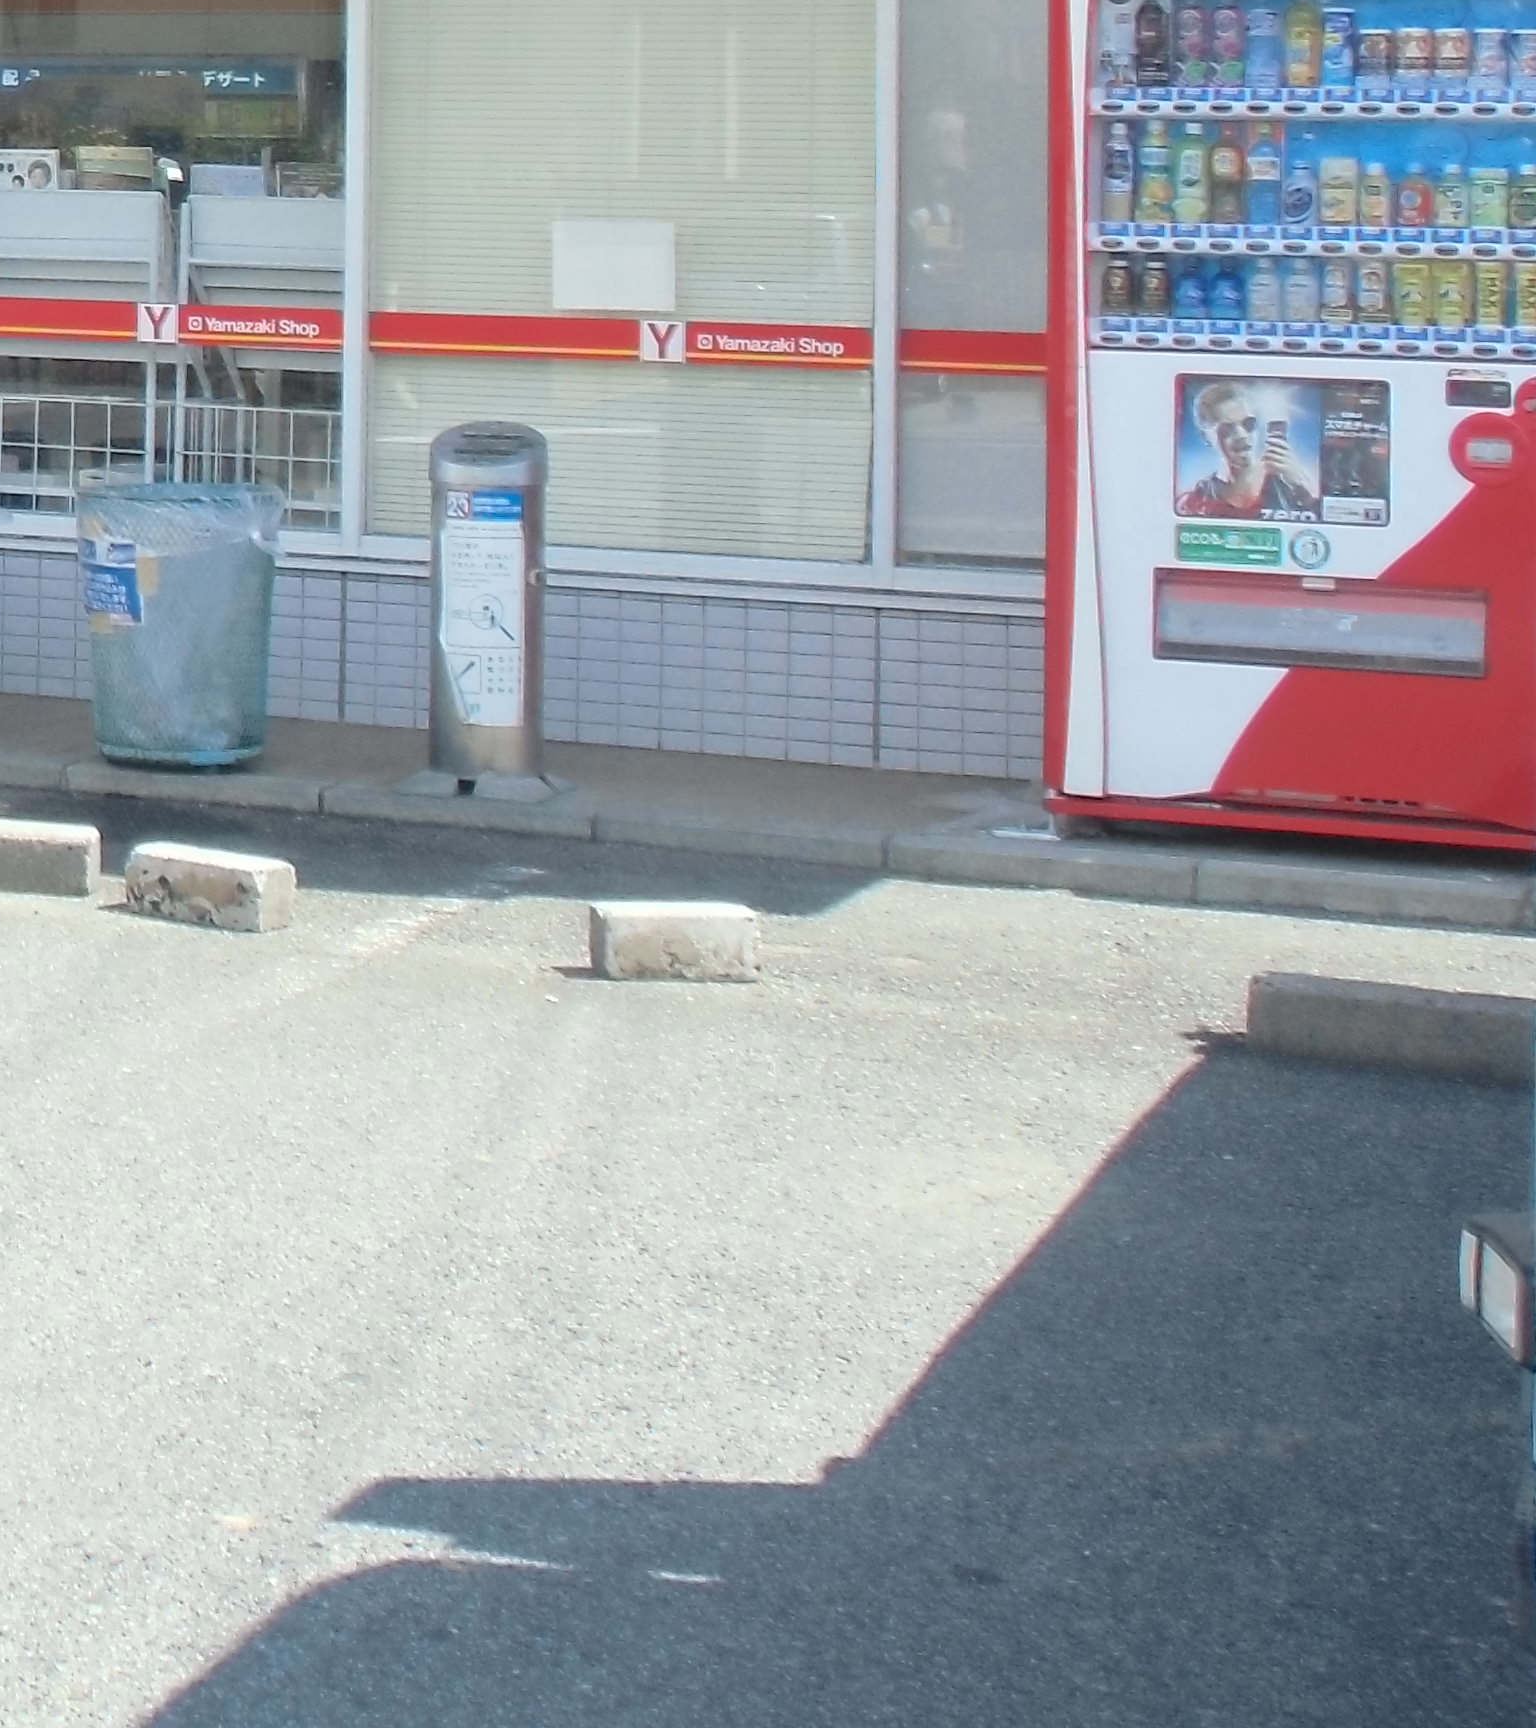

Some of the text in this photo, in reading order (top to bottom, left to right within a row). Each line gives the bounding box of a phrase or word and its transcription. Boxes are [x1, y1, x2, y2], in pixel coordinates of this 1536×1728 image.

[205, 317, 320, 338] Yamazaki Shop
[716, 335, 845, 357] Yamazaki Shop
